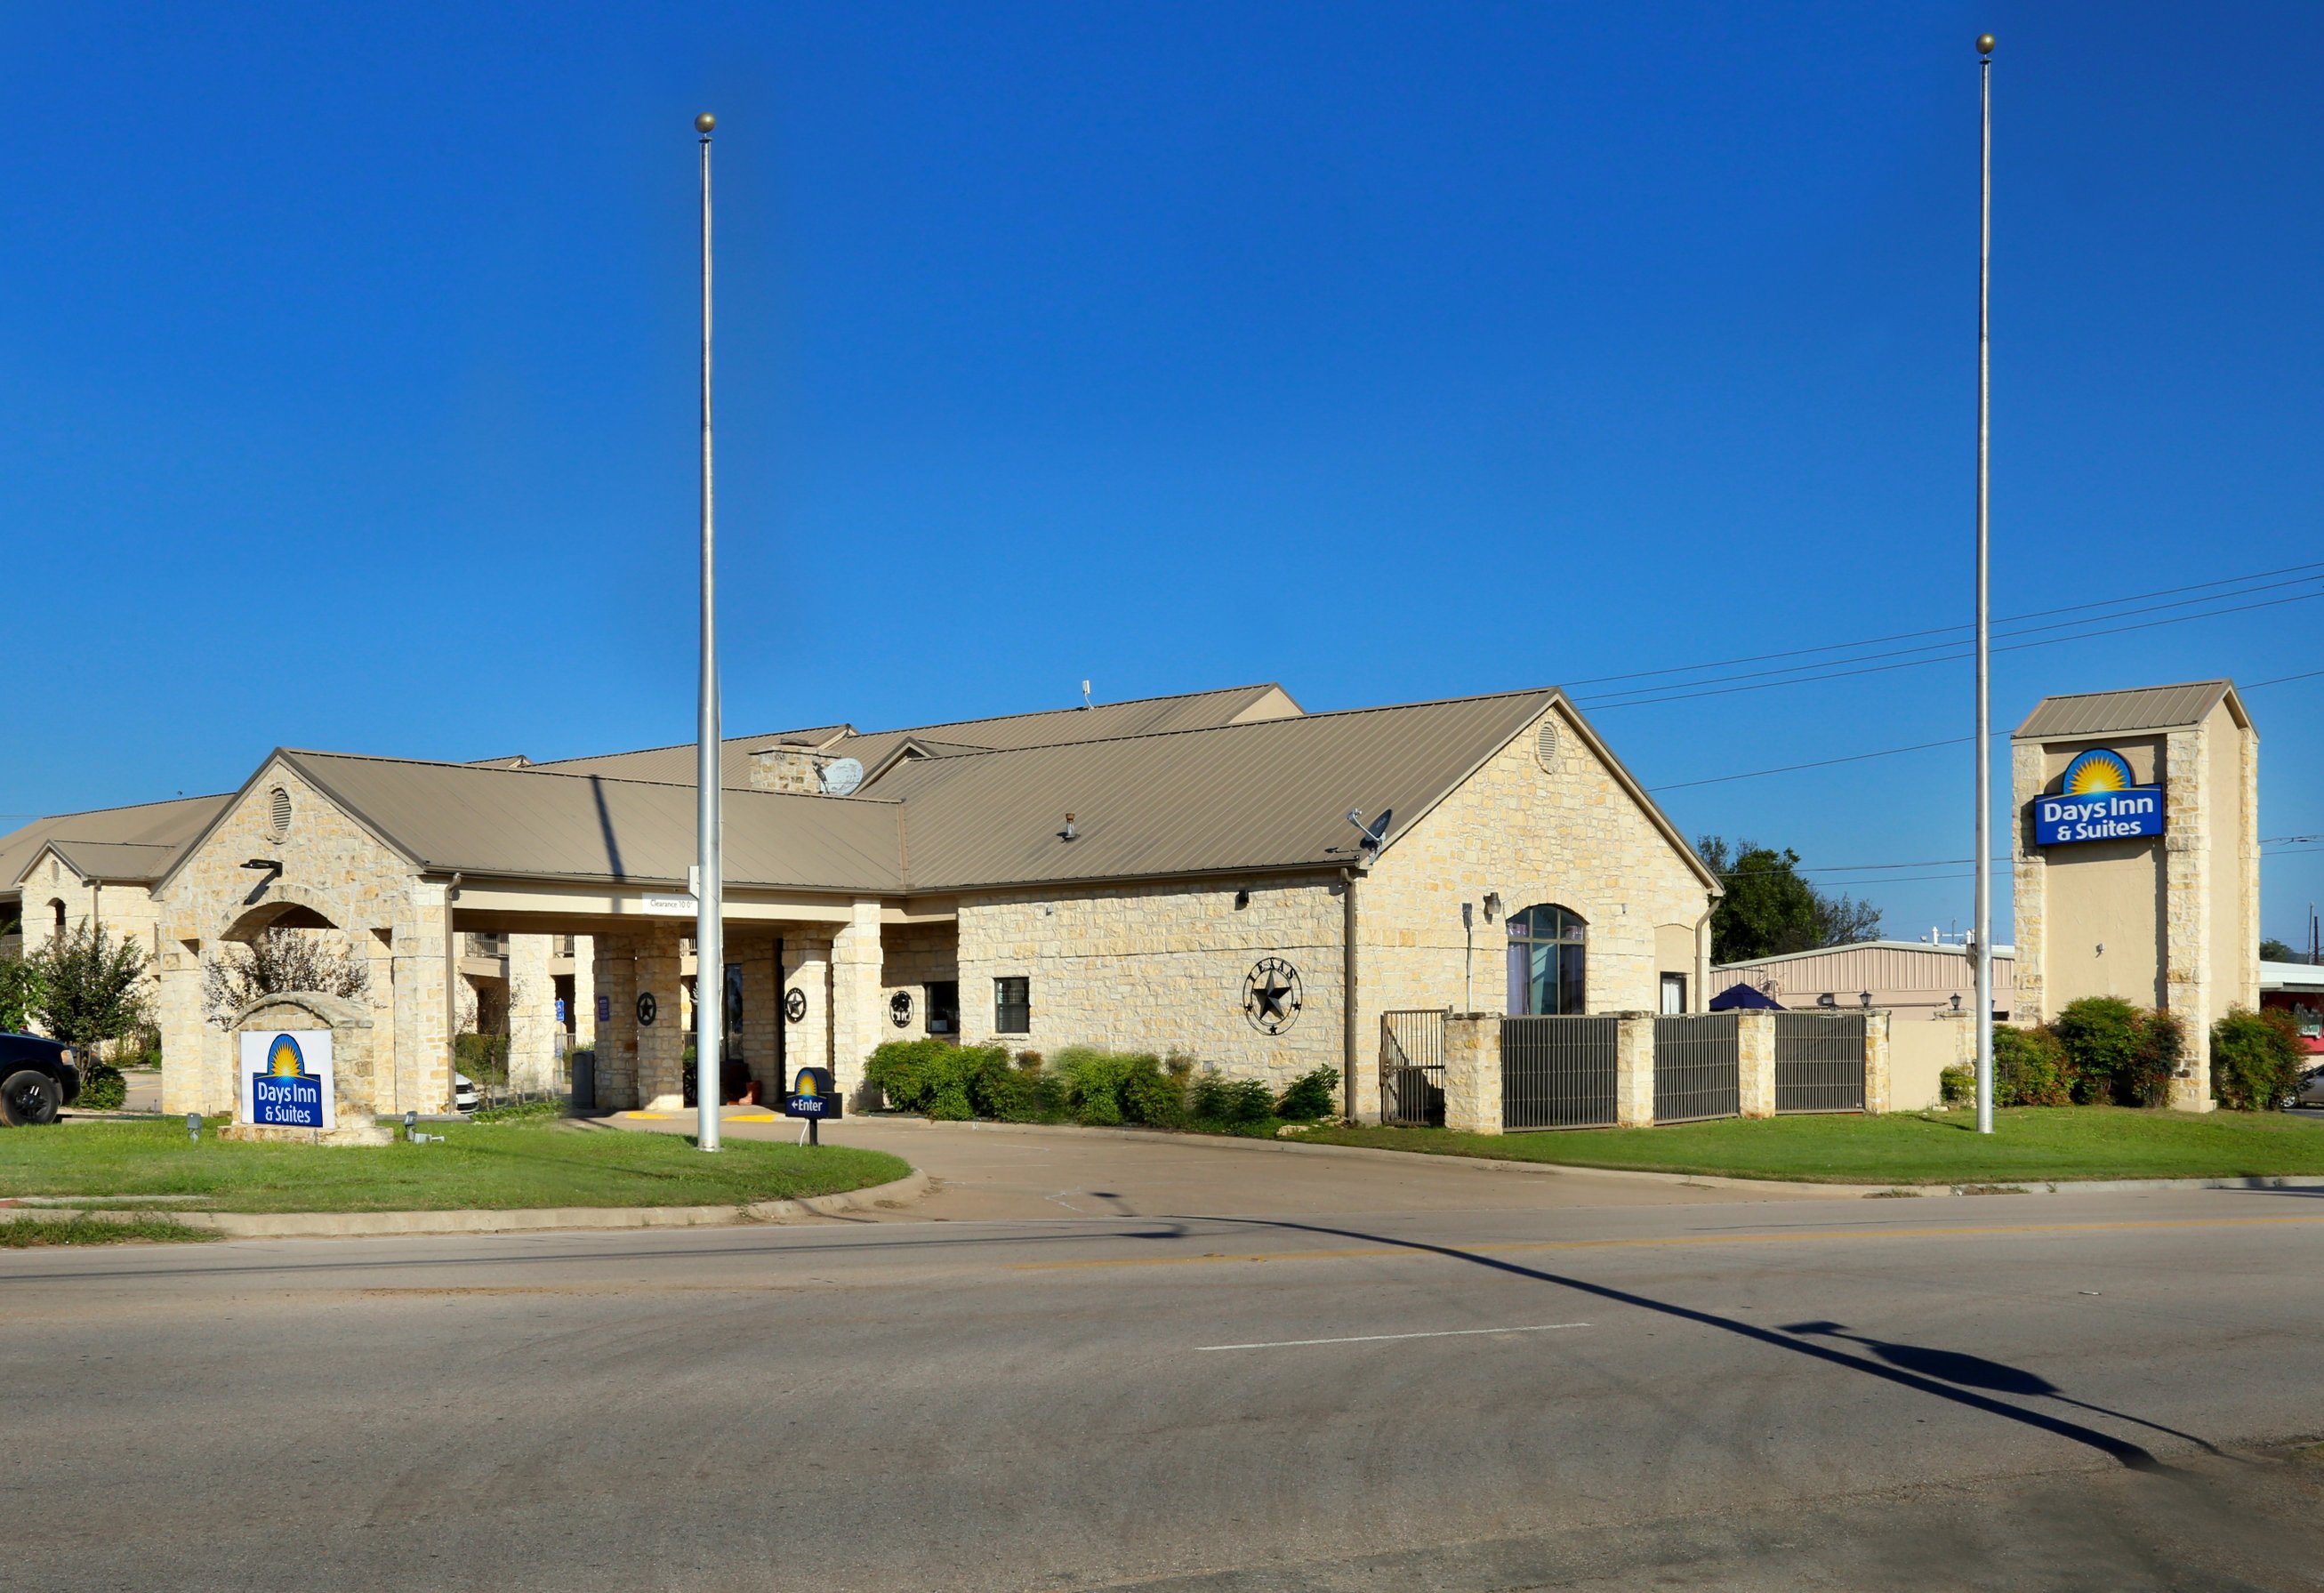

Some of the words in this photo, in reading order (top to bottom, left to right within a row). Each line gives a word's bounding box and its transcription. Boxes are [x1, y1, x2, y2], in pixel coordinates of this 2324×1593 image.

[2044, 802, 2107, 822] Days
[2111, 797, 2153, 816] Inn
[2056, 825, 2071, 841] &
[2075, 819, 2142, 840] Suites
[650, 898, 678, 907] Clearance
[1247, 957, 1297, 982] TEXAS
[258, 1082, 292, 1104] Days
[293, 1083, 317, 1103] Inn
[265, 1106, 273, 1121] &
[275, 1105, 311, 1123] Suites
[798, 1098, 823, 1111] Enter
